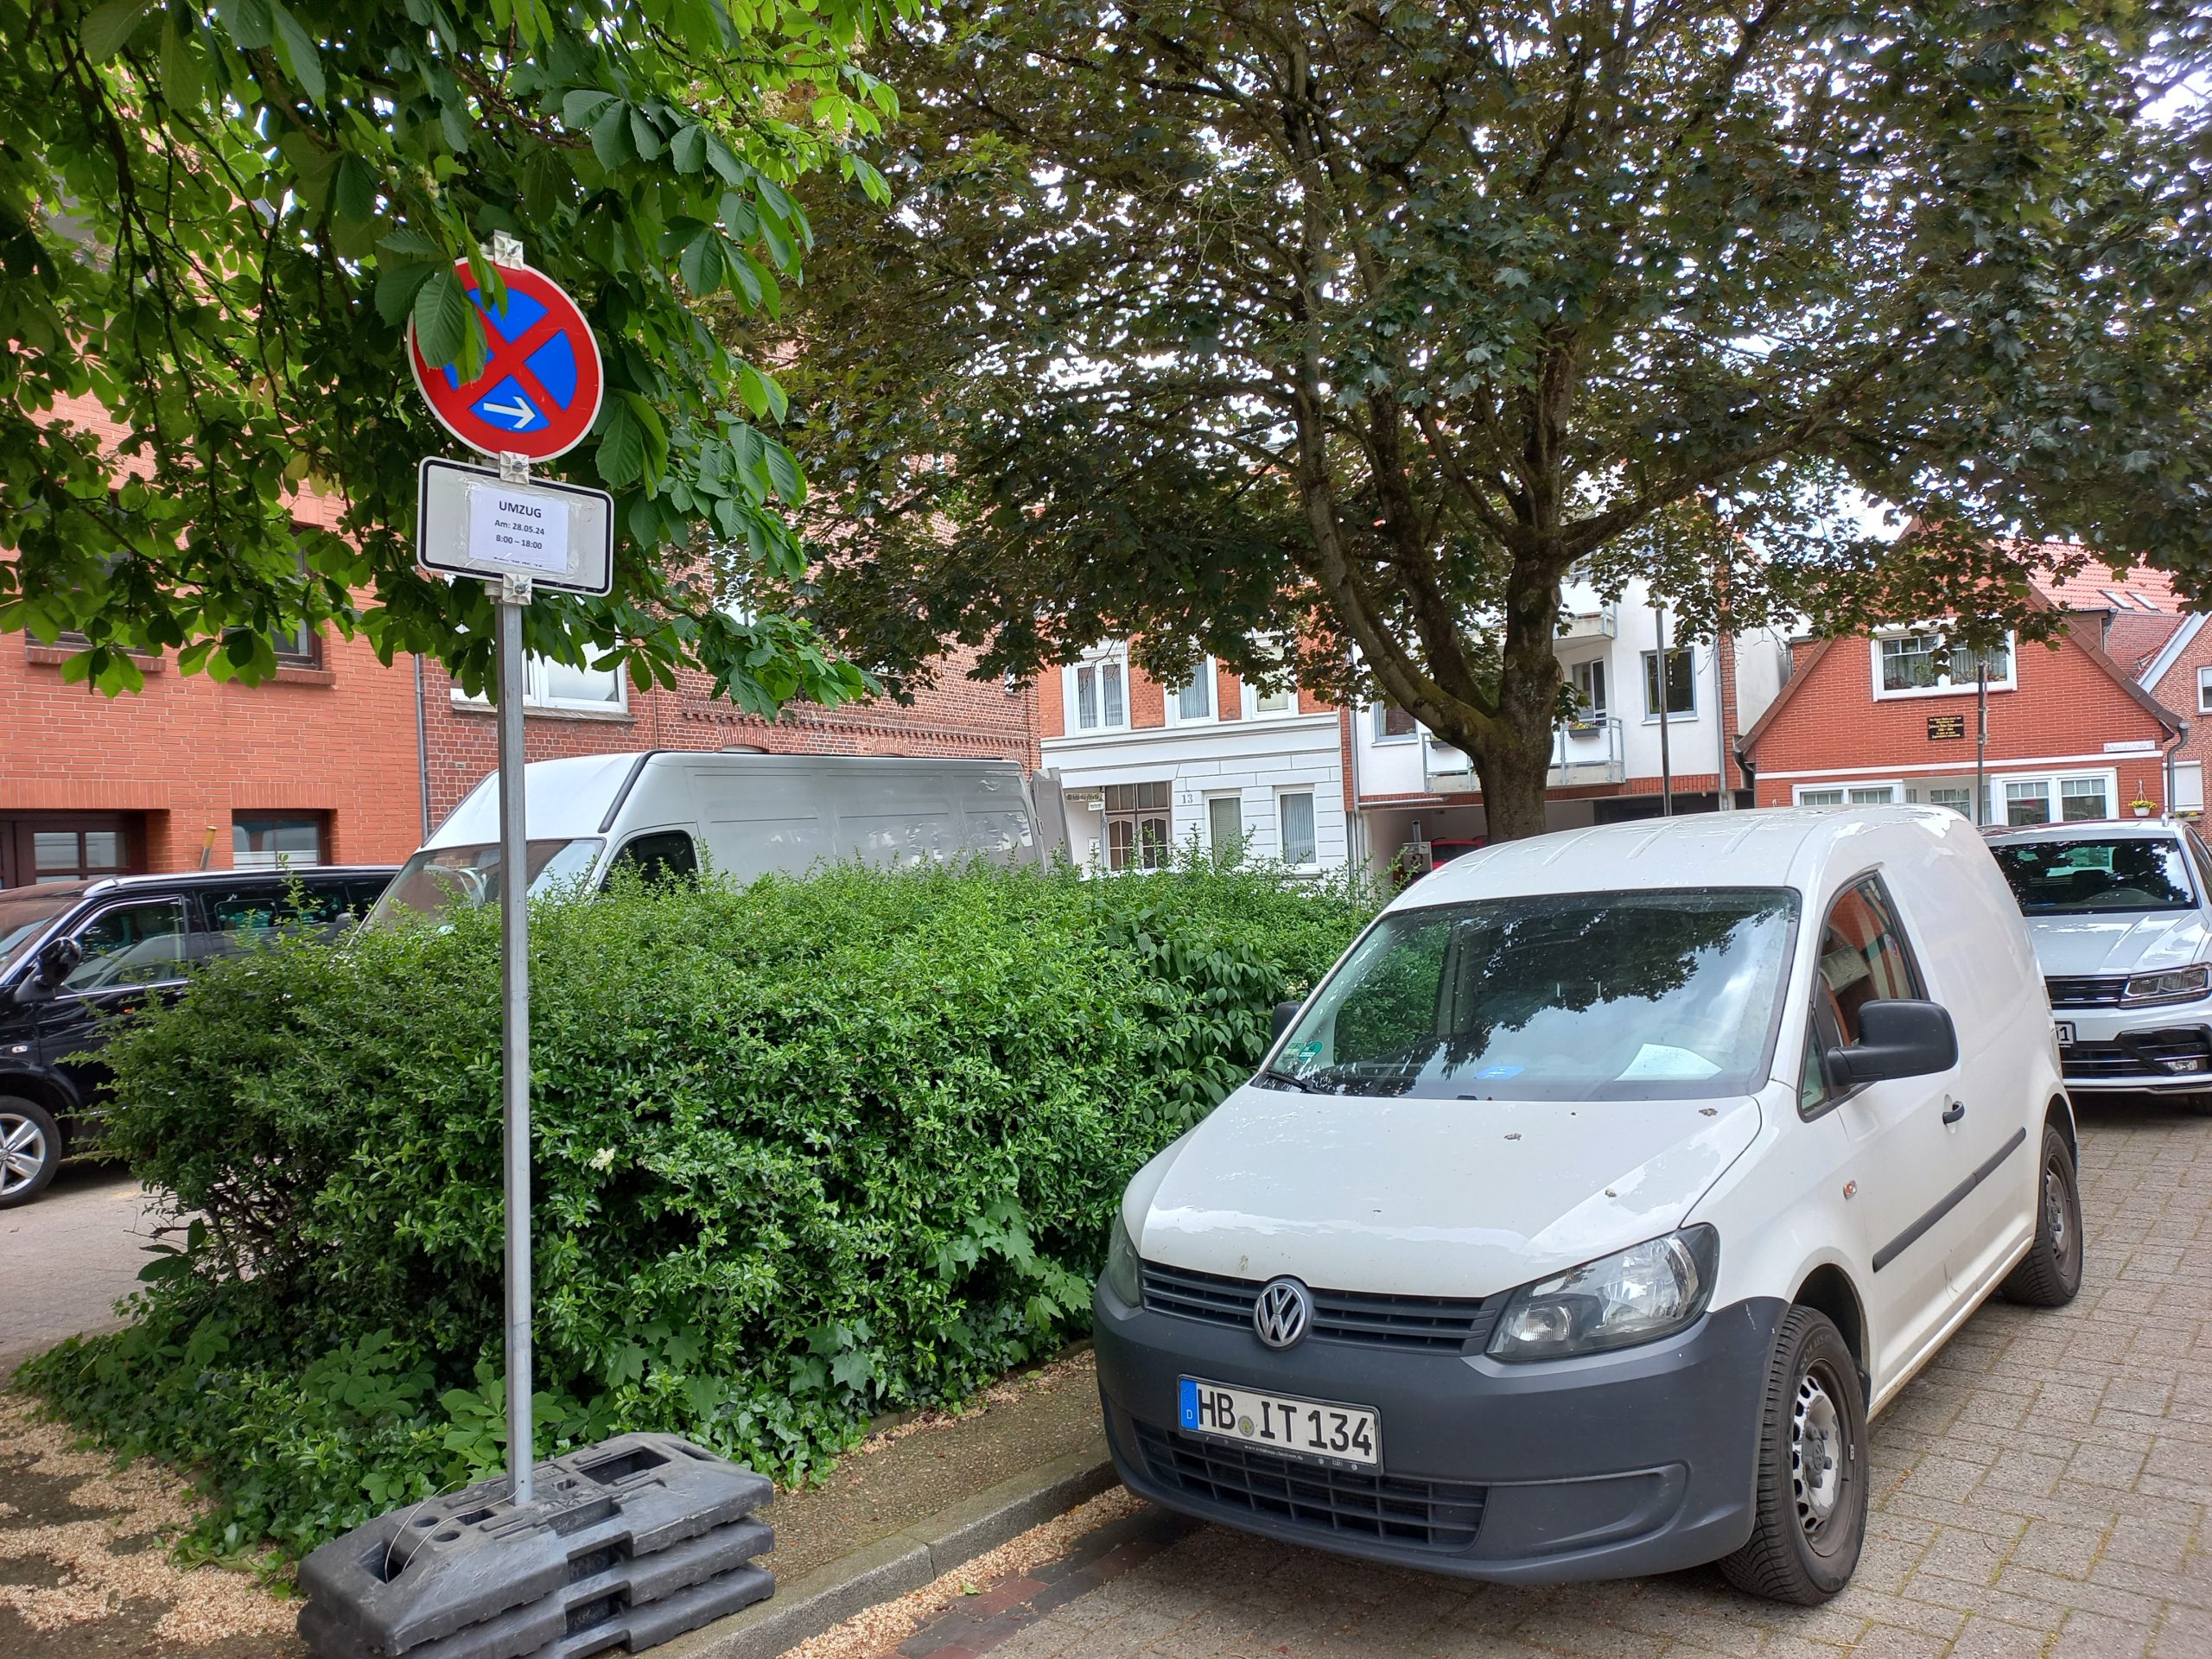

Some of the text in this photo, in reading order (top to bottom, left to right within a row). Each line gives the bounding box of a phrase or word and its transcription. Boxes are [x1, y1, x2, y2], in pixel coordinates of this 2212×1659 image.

[499, 500, 542, 518] UMZUG
[494, 519, 545, 535] Am: 28.05.24
[495, 534, 513, 544] 8:00
[521, 539, 543, 550] 18:00
[1181, 794, 1193, 804] 13
[1186, 1389, 1372, 1456] D HB IT 134
